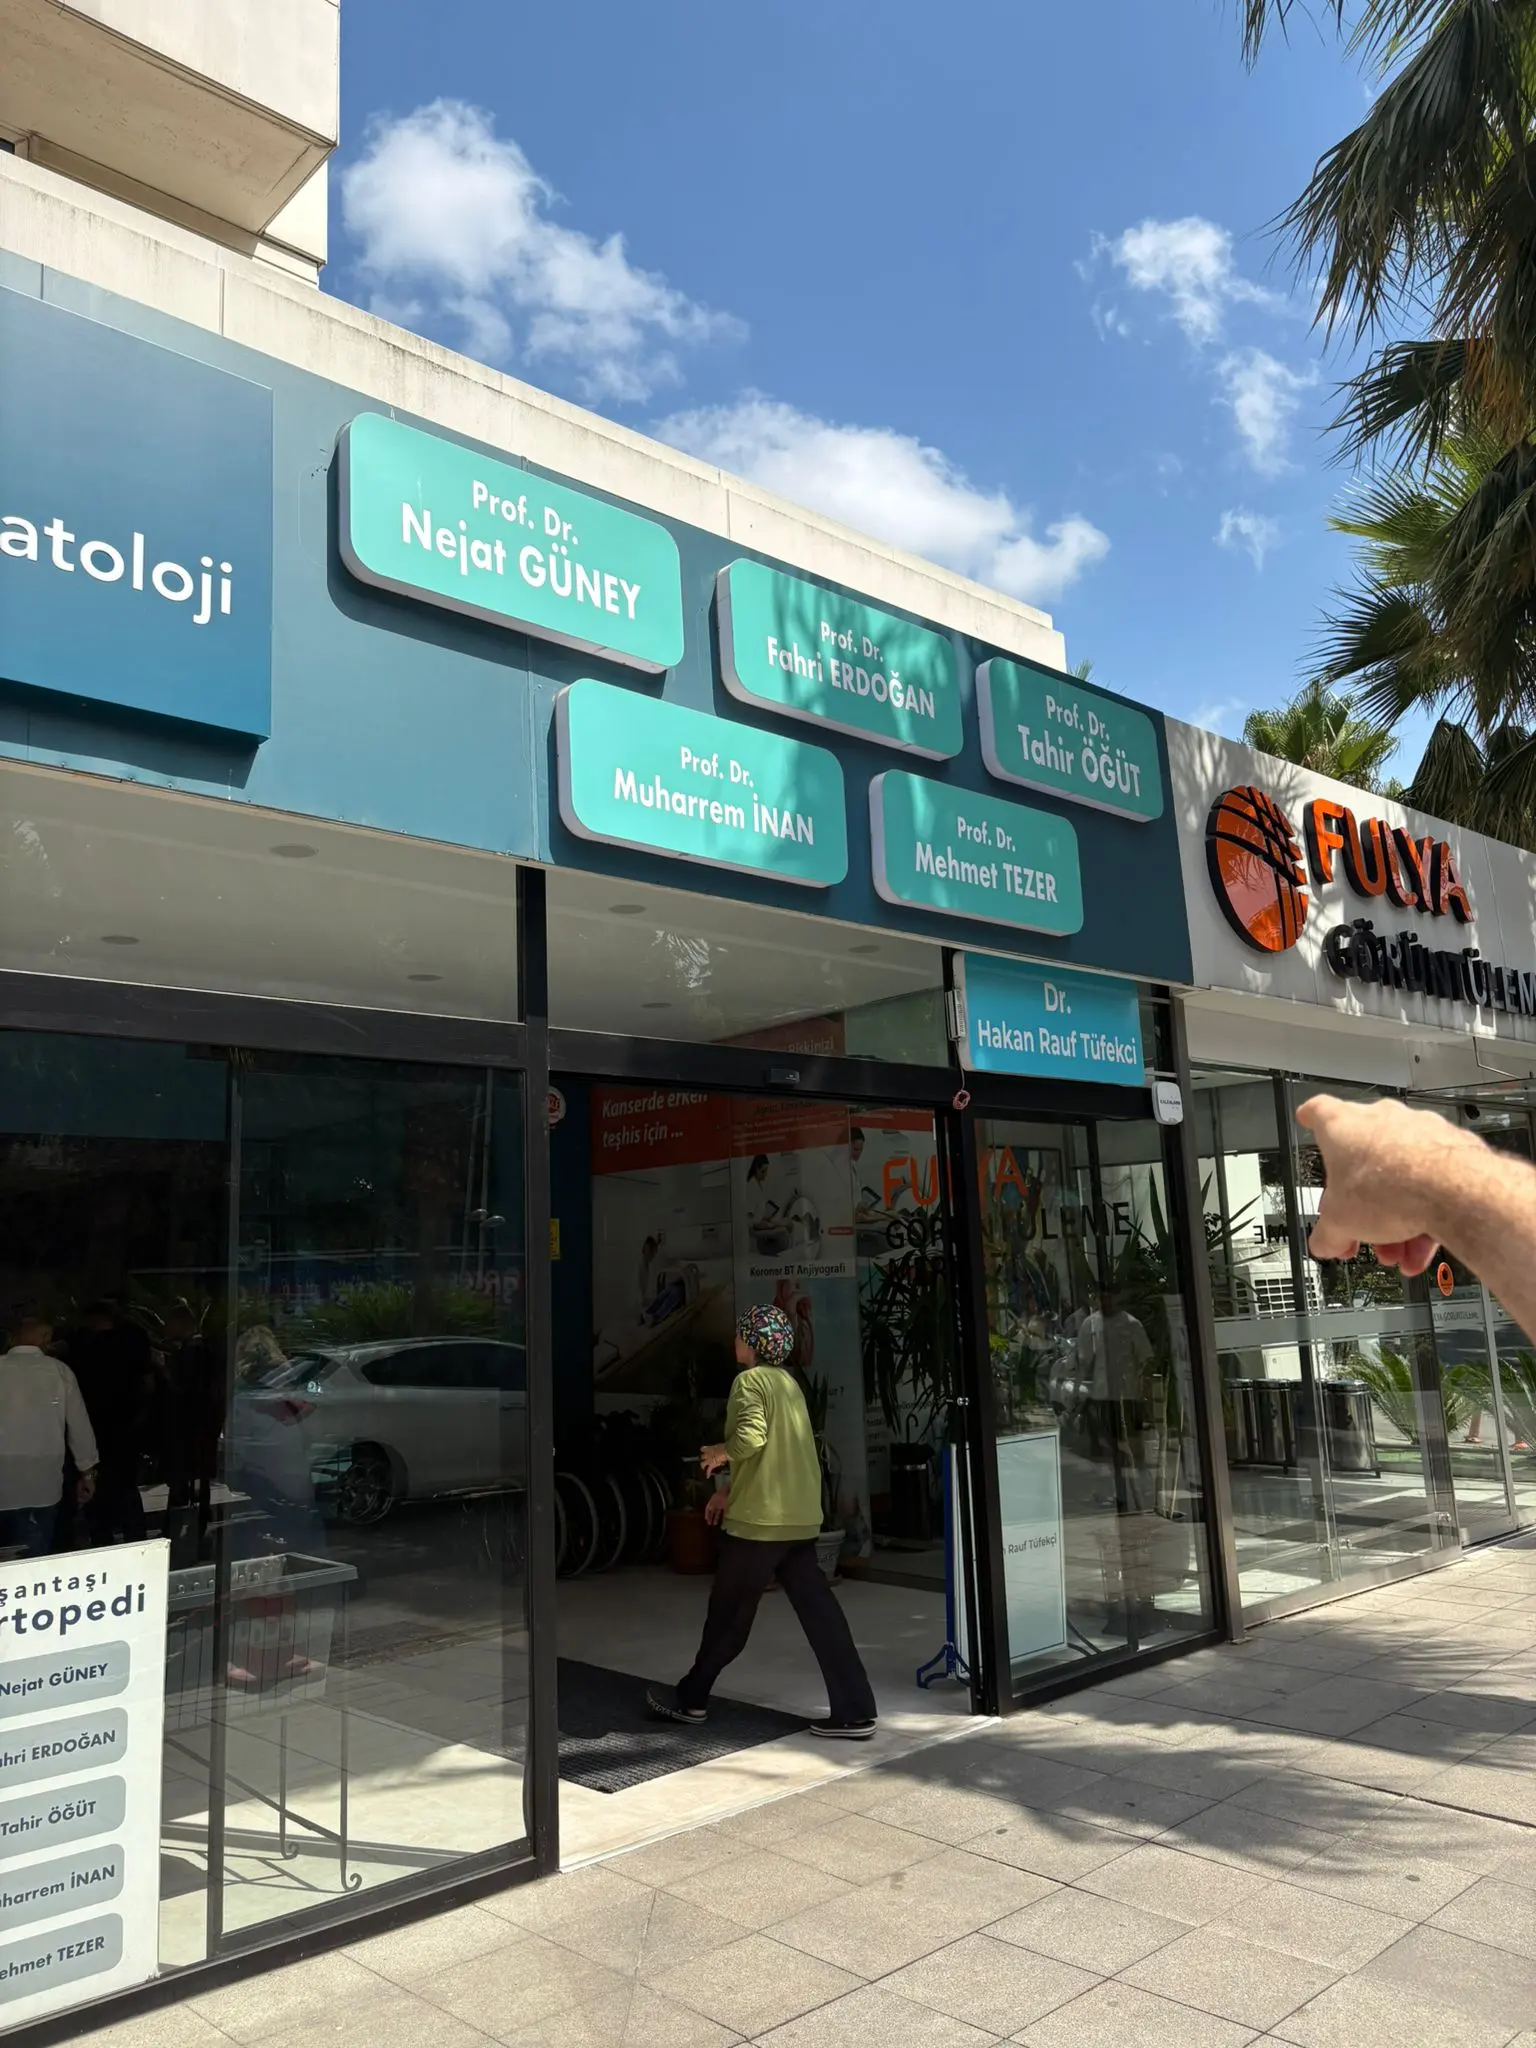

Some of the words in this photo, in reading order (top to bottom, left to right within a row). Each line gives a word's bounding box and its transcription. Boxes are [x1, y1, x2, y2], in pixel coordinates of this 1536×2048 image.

[472, 479, 534, 530] Prof.
[544, 506, 578, 545] Dr.
[0, 516, 232, 625] atoloji
[401, 501, 507, 576] Nejat
[519, 542, 641, 620] GÜNEY
[820, 621, 858, 654] Prof.
[862, 636, 884, 662] Dr.
[767, 636, 823, 682] Fahri
[830, 657, 935, 720] ERDOĞAN
[1046, 694, 1084, 731] Prof.
[1088, 711, 1110, 741] Dr.
[680, 746, 724, 779] Prof.
[730, 760, 754, 788] Dr.
[1018, 724, 1075, 775] Tahir
[1081, 736, 1141, 797] ÖĞÜT
[613, 767, 745, 829] Muharrem
[753, 793, 814, 845] İNAN
[957, 816, 992, 846] Prof.
[996, 827, 1016, 852] Dr.
[915, 841, 998, 889] Mehmet
[1003, 862, 1058, 903] TEZER
[1304, 798, 1475, 924] FULYA
[1043, 982, 1072, 1014] Dr.
[977, 1019, 1034, 1052] Hakan
[1039, 1027, 1077, 1058] Rauf
[602, 1124, 641, 1151] teşhis
[643, 1121, 669, 1146] için
[1008, 1540, 1027, 1554] Rauf
[0, 1679, 43, 1697] Nejat
[49, 1663, 108, 1686] GÜNEY
[32, 1730, 116, 1760] ERDOĞAN
[0, 1815, 43, 1836] Tahir
[48, 1799, 97, 1824] ÖĞÜT
[0, 1882, 65, 1908] harrem
[70, 1864, 115, 1889] İNAN
[0, 1953, 52, 1980] ehmet
[57, 1936, 105, 1962] TEZER
